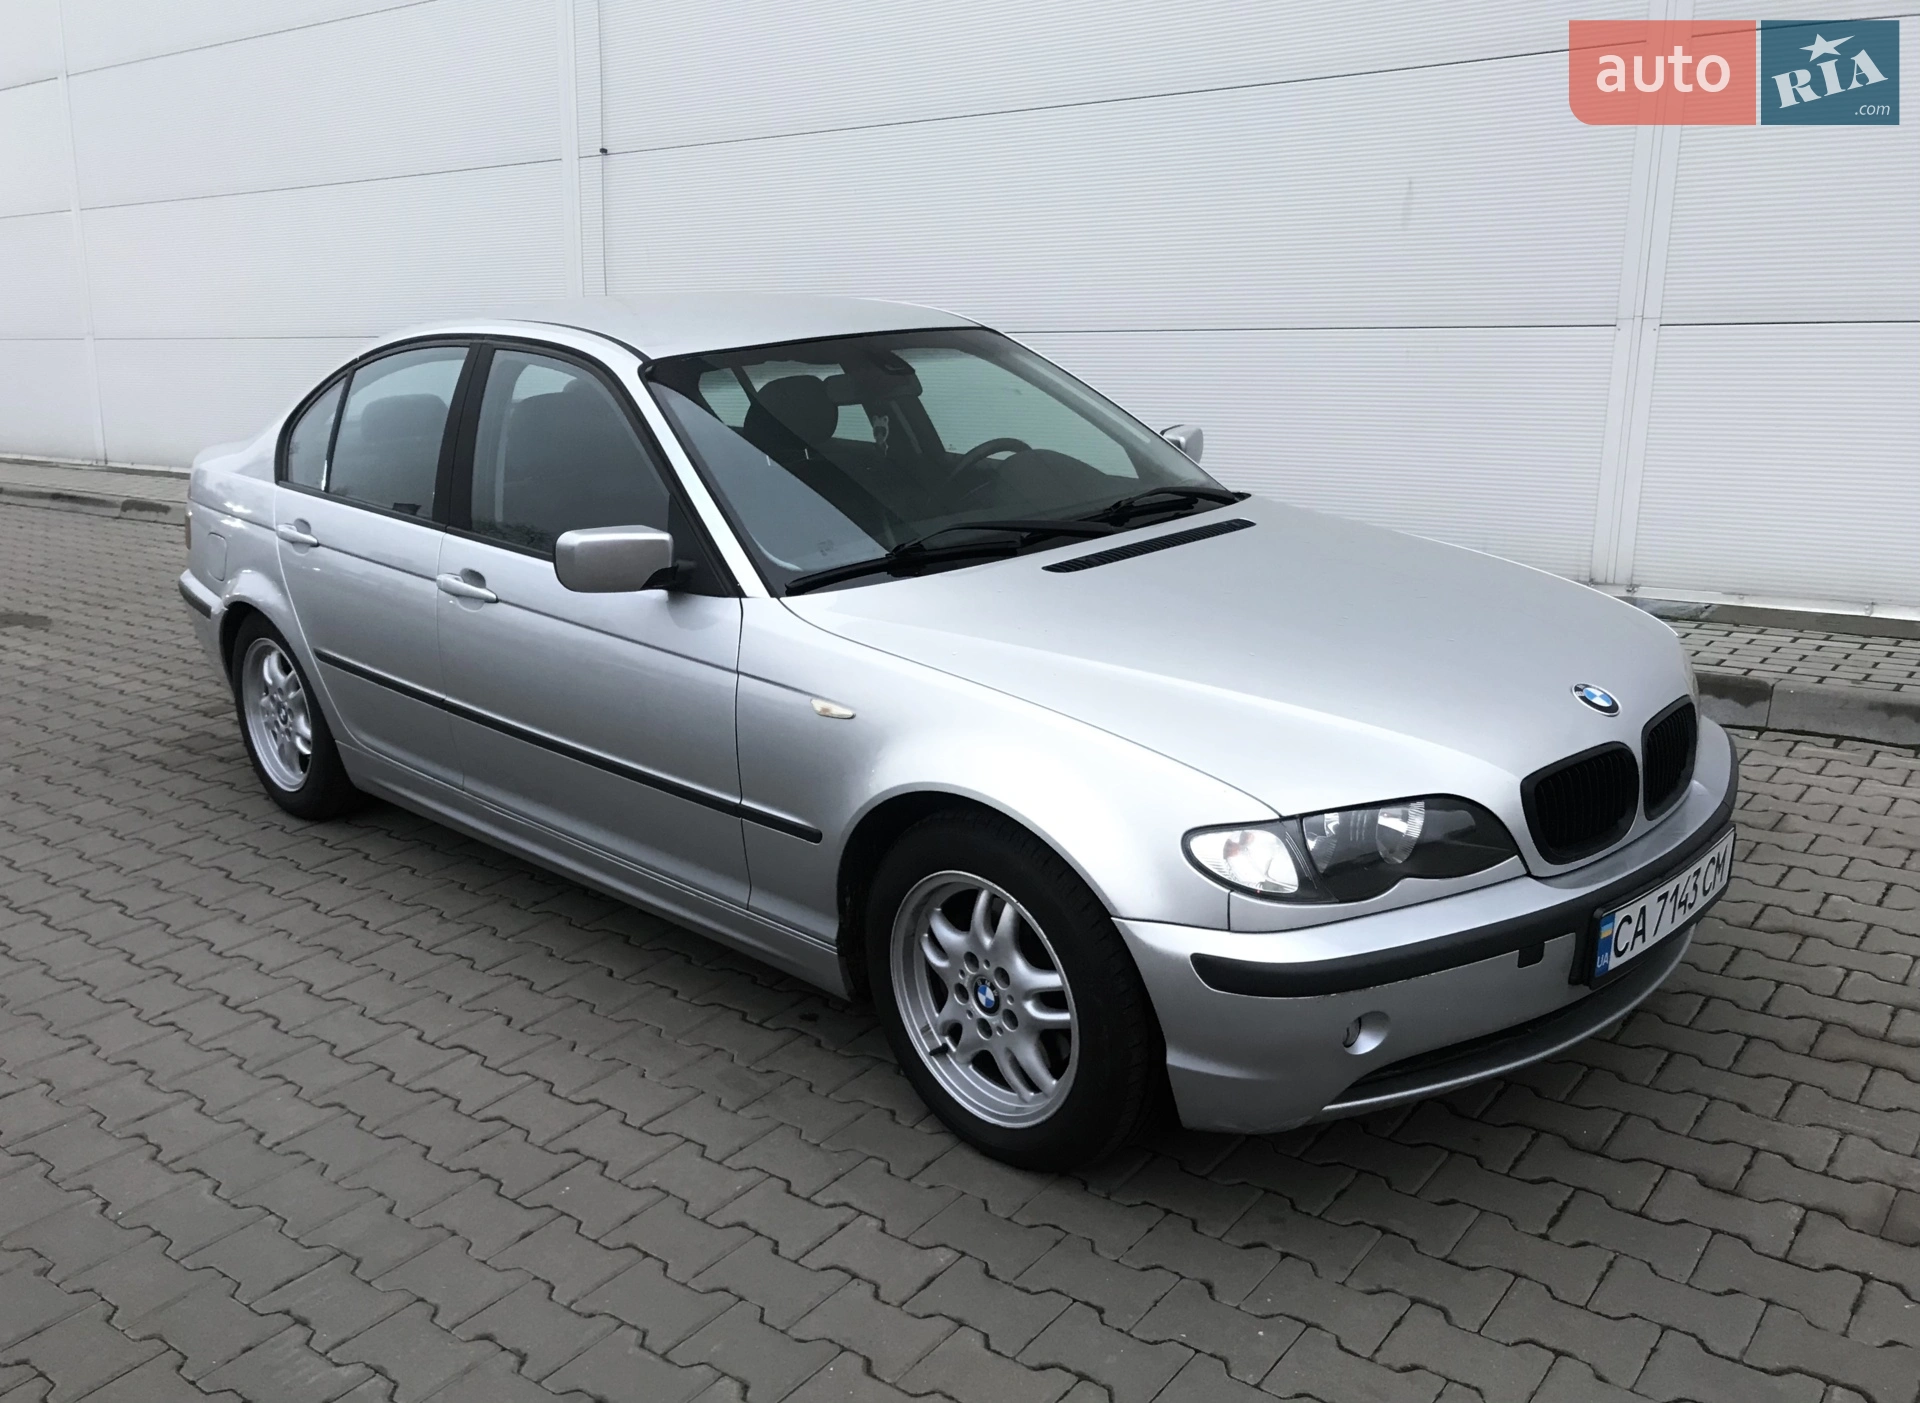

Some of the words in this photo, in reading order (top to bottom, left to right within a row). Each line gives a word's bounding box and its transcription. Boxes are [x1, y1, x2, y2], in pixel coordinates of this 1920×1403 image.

[1613, 904, 1647, 958] CA
[1653, 867, 1702, 937] 7143
[1702, 844, 1728, 897] CM
[1597, 952, 1609, 968] UA
